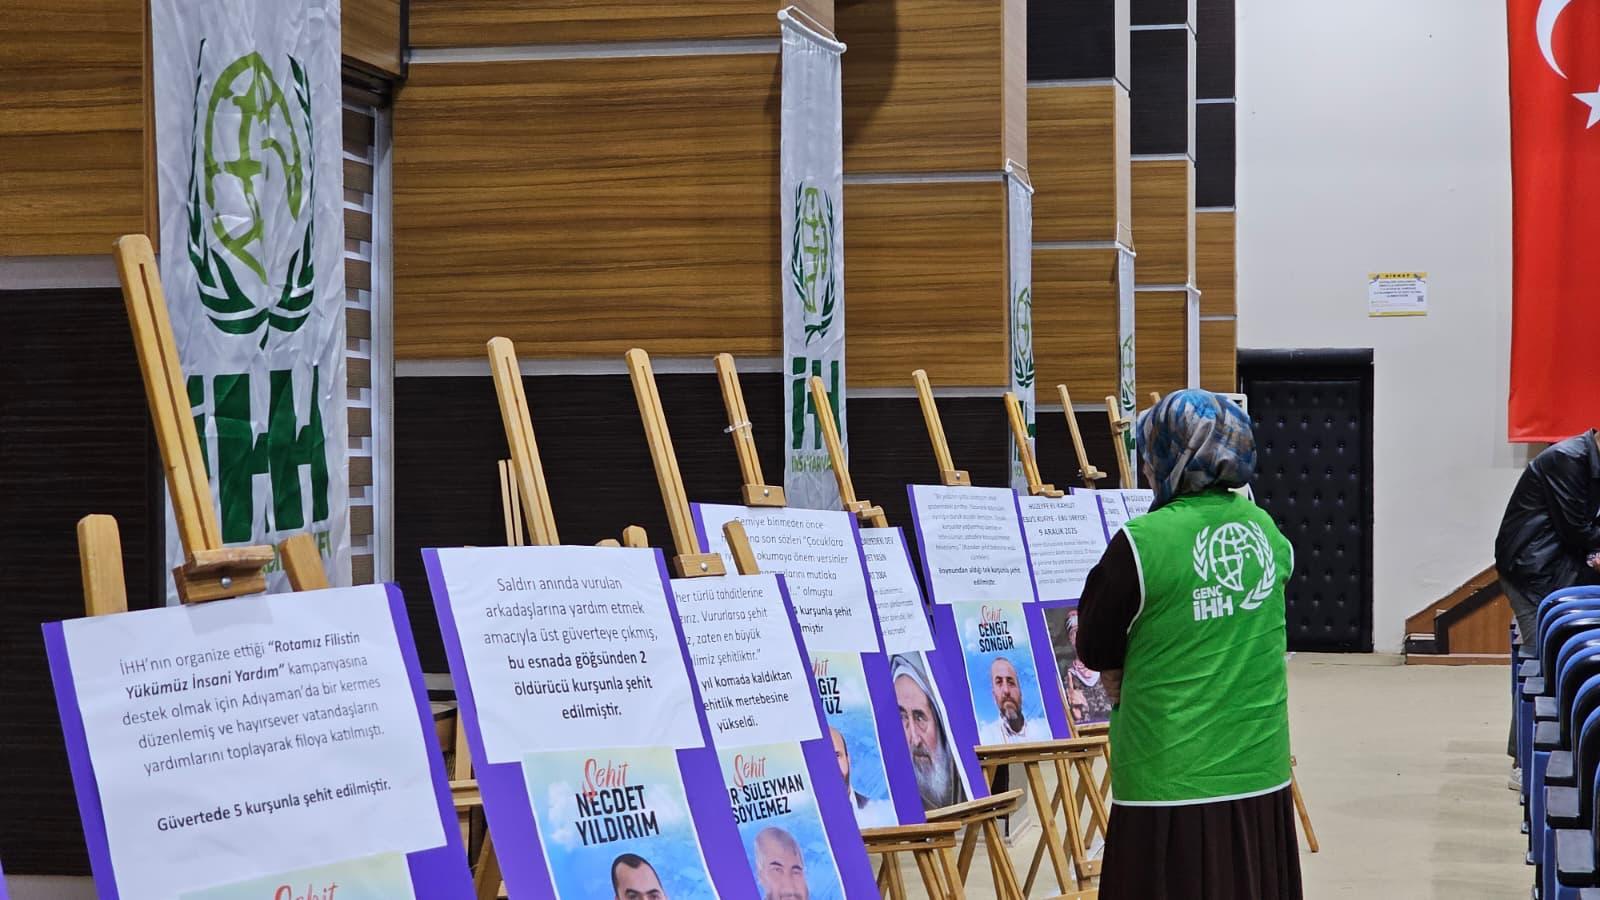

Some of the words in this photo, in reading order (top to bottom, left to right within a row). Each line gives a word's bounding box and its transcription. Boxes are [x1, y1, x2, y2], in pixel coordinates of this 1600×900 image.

[761, 536, 776, 544] son
[778, 535, 802, 545] sözleri
[757, 552, 792, 564] okumaya
[794, 553, 815, 562] önem
[497, 577, 536, 592] Saldırı
[539, 576, 579, 590] anında
[581, 576, 623, 590] vurulan
[807, 570, 837, 580] mutlaka
[675, 592, 690, 603] her
[693, 589, 714, 602] türlü
[803, 586, 833, 598] olmuştu
[486, 602, 567, 620] arkadaşlarına
[569, 601, 608, 617] yardım
[611, 601, 645, 614] etmek
[702, 608, 746, 622] Vururlarsa
[747, 607, 768, 621] şehit
[799, 606, 833, 617] kurşunla
[834, 606, 853, 618] şehit
[484, 628, 537, 646] amacıyla
[540, 628, 558, 642] üst
[562, 627, 619, 644] güverteye
[621, 625, 658, 642] çıkmış,
[697, 633, 722, 645] zaten
[724, 632, 734, 642] en
[735, 628, 761, 644] büyük
[978, 620, 1009, 637] CENGİZ
[175, 648, 231, 668] organize
[233, 642, 265, 658] ettiği
[324, 632, 361, 647] Filistin
[979, 636, 1014, 653] SONGÜR
[508, 655, 525, 669] bu
[528, 653, 572, 668] esnada
[575, 650, 637, 669] göğsünden
[639, 650, 647, 664] 2
[693, 653, 714, 666] limiz
[126, 678, 189, 699] Yükümüz
[192, 671, 232, 689] İnsani
[287, 656, 368, 675] kampanyasına
[514, 679, 570, 696] öldürücü
[572, 676, 624, 694] kurşunla
[625, 675, 653, 692] şehit
[701, 675, 713, 692] yıl
[714, 673, 751, 688] komada
[751, 670, 792, 685] kaldıktan
[818, 677, 840, 695] GİZ
[122, 706, 168, 726] destek
[171, 699, 213, 718] olmak
[215, 696, 239, 713] için
[322, 681, 337, 696] bir
[340, 678, 381, 693] kermes
[561, 702, 622, 719] edilmiştir.
[704, 695, 734, 711] ehitlik
[735, 692, 789, 708] mertebesine
[138, 725, 215, 749] düzenlemiş
[218, 723, 233, 736] ve
[236, 713, 299, 733] hayırsever
[302, 702, 379, 722] vatandaşların
[717, 715, 759, 734] yükseldi.
[144, 751, 224, 777] yardımlarını
[227, 737, 293, 760] toplayarak
[295, 732, 328, 749] filoya
[330, 724, 385, 742] katılmıştı.
[742, 774, 805, 802] SÜLEYMAN
[157, 805, 231, 831] Güvertede
[233, 803, 243, 817] 5
[244, 794, 301, 816] kurşunla
[303, 788, 334, 807] şehit
[335, 778, 391, 799] edilmiştir.
[575, 785, 645, 818] NECDET
[731, 796, 792, 825] SÖYLEMEZ
[575, 810, 660, 846] YILDIRIM
